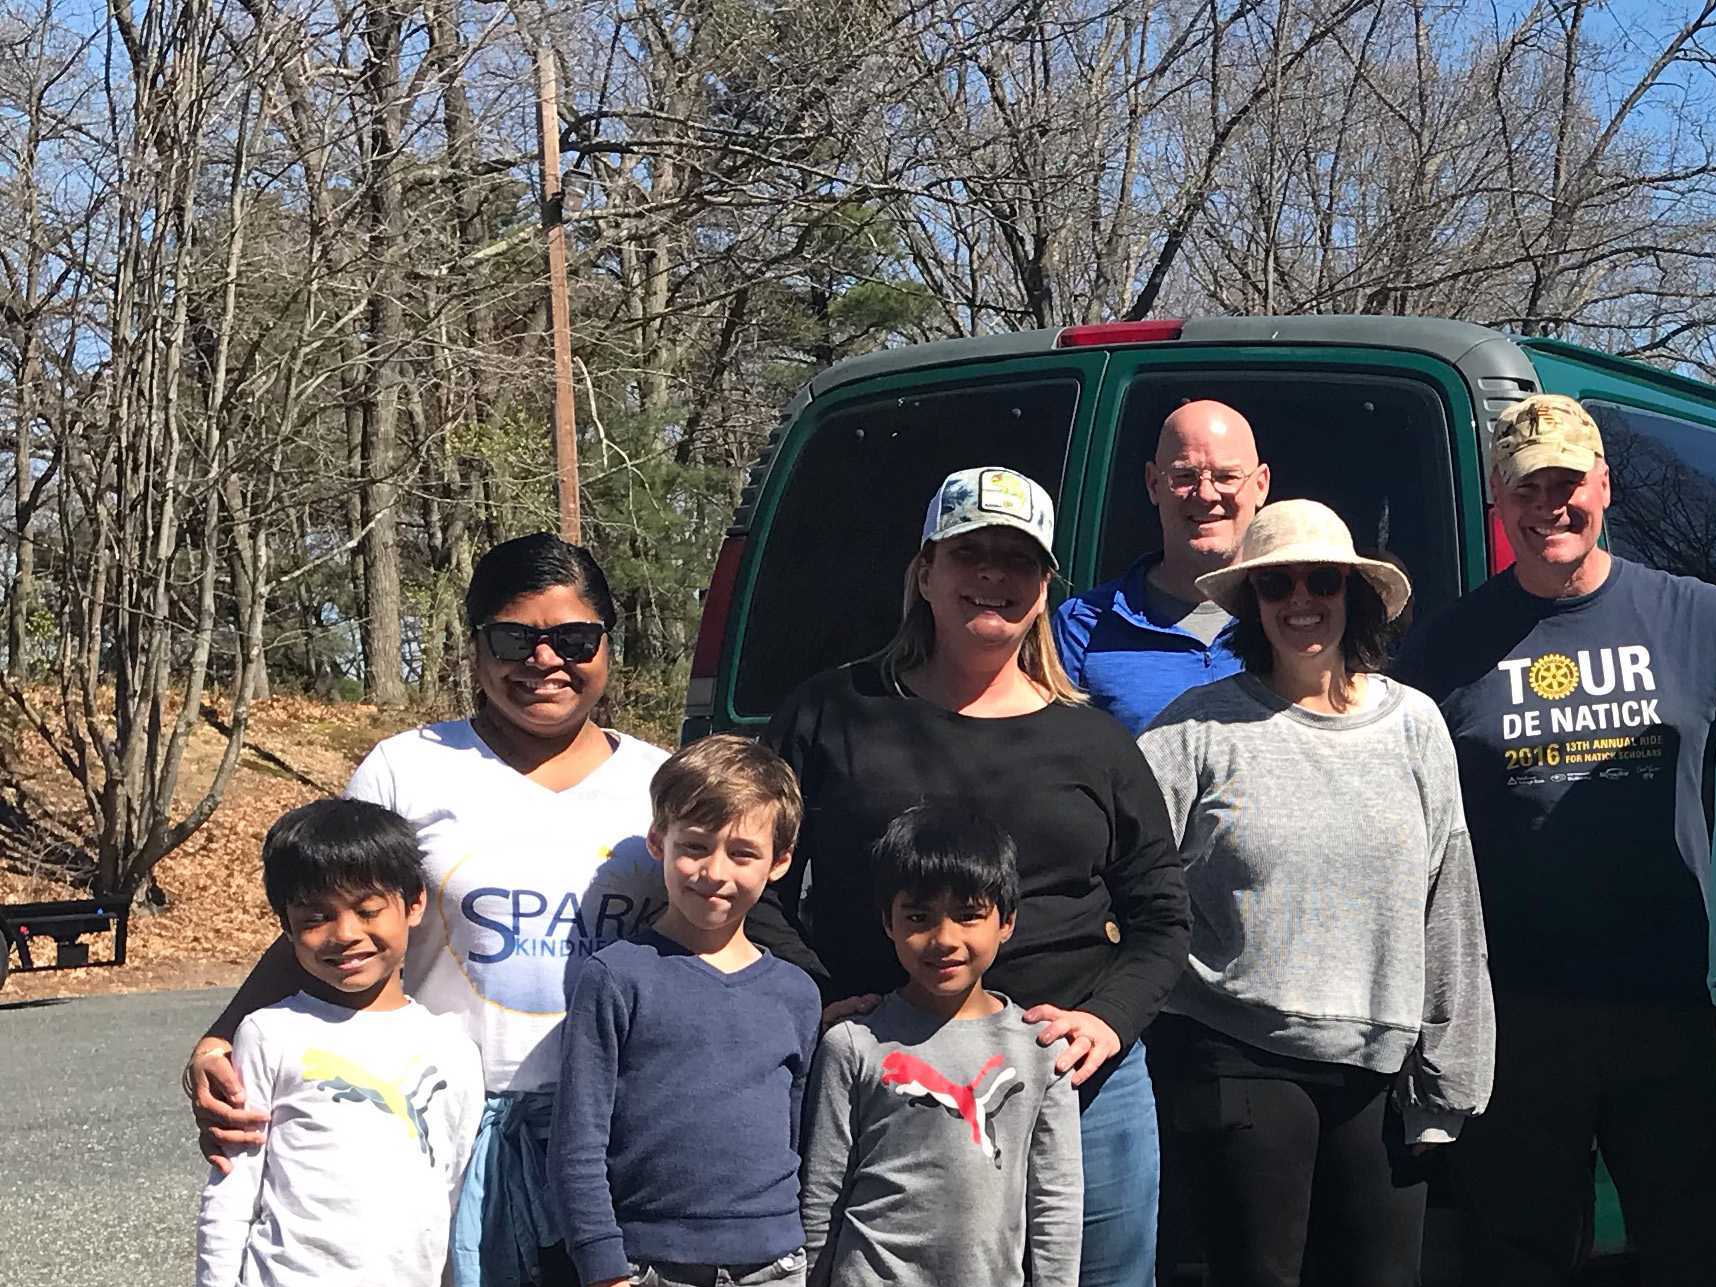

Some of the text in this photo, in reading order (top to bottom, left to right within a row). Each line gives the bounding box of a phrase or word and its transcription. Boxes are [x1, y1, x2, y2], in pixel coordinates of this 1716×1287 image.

[1498, 645, 1656, 705] TOUR
[1503, 699, 1662, 740] DE NATICK
[1504, 743, 1561, 769] 2016
[1565, 739, 1590, 752] 13TH
[1592, 736, 1637, 749] ANNUAL
[1565, 753, 1583, 764] FOR
[1584, 751, 1617, 762] NATICK
